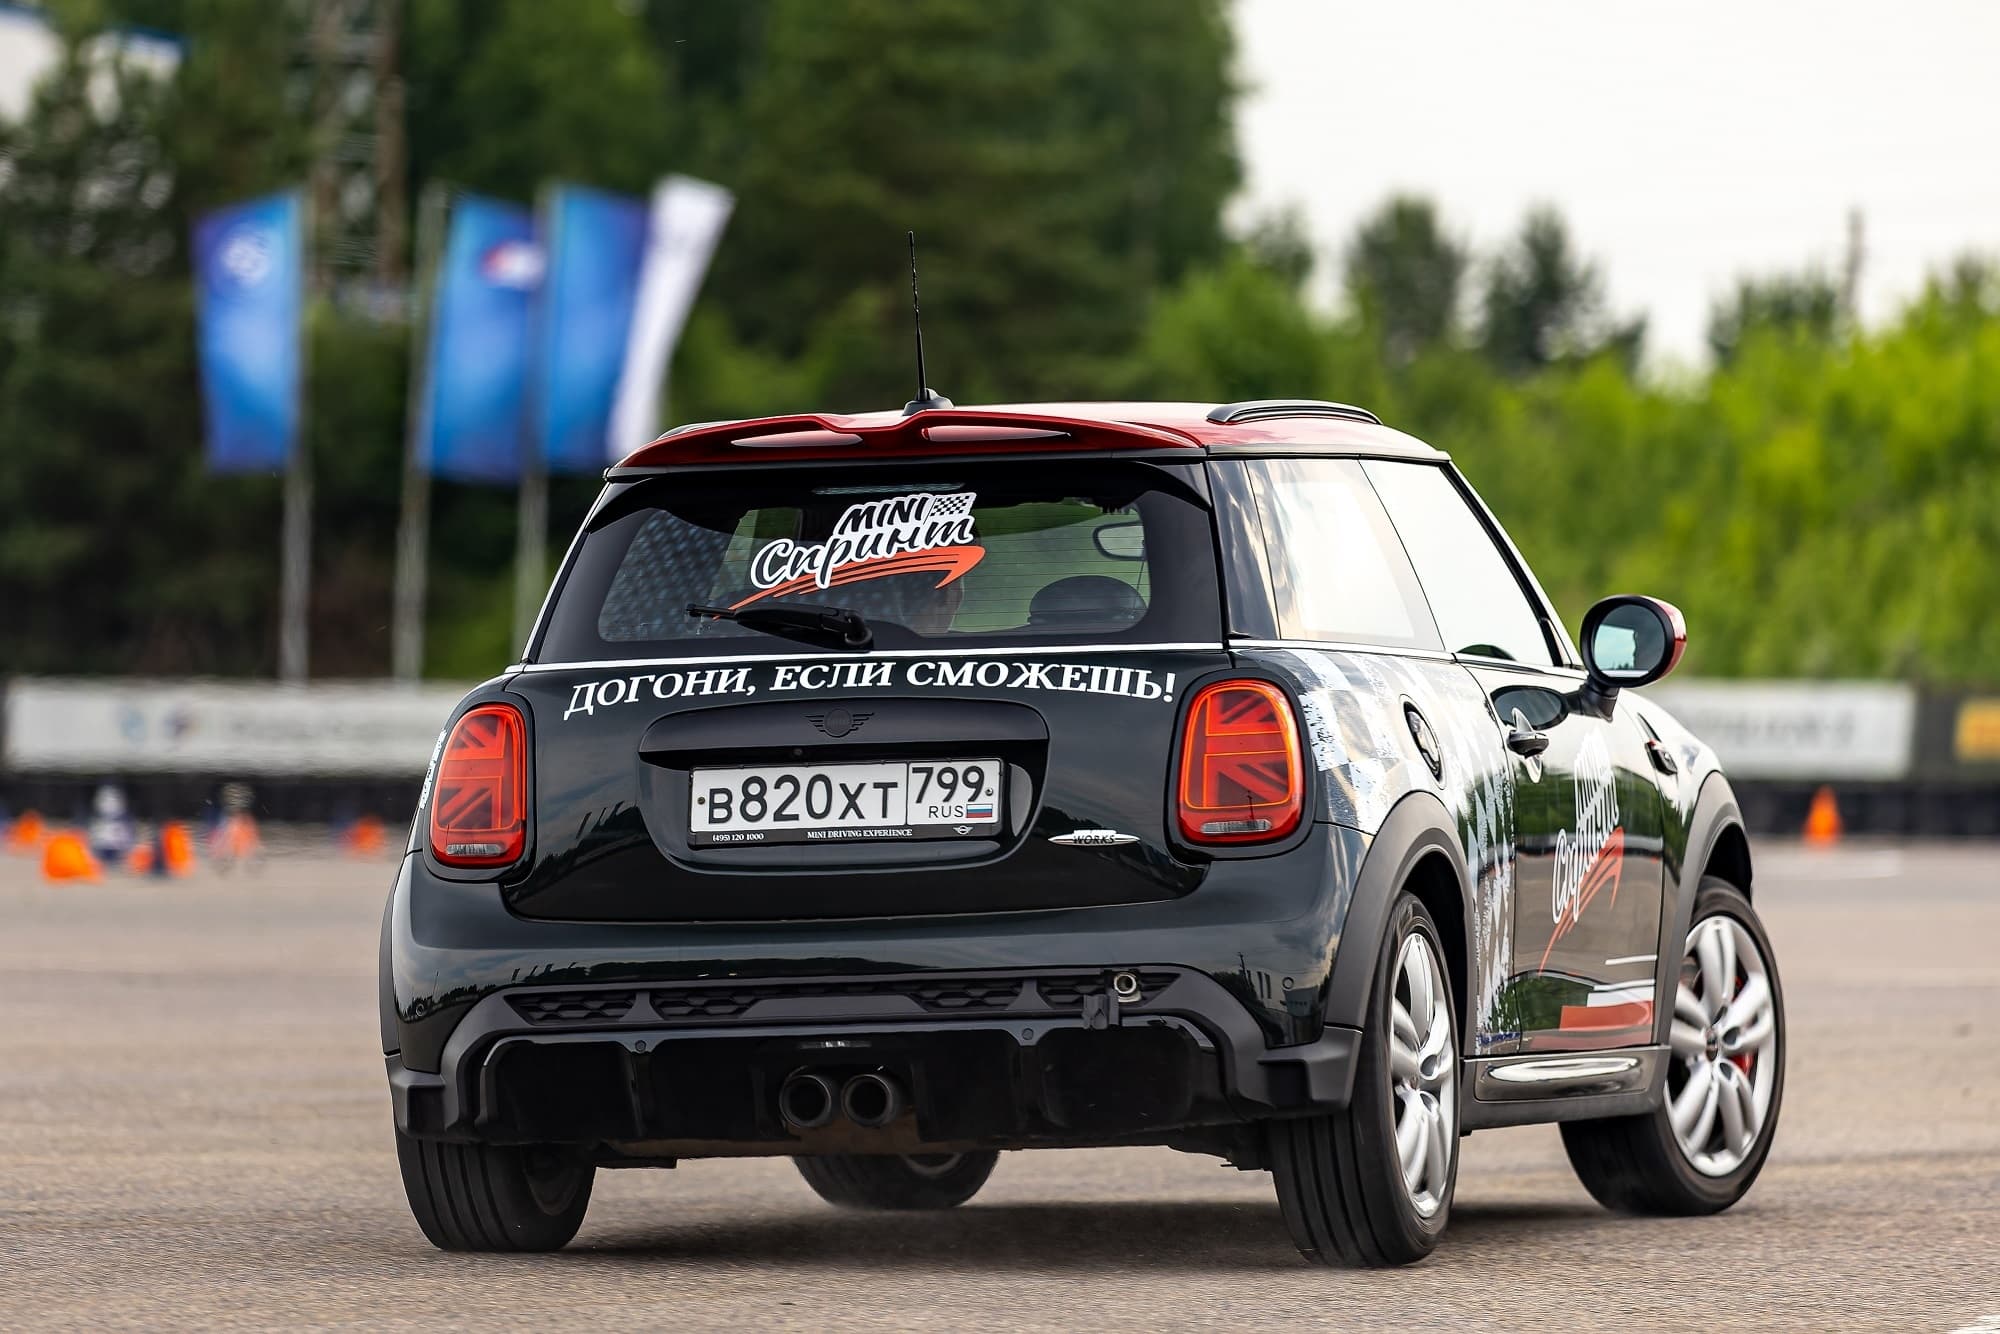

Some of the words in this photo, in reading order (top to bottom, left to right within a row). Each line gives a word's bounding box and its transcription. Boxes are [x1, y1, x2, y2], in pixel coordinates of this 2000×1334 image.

[836, 496, 930, 536] MINI
[752, 516, 972, 588] Спринт
[564, 667, 756, 721] ДОГОНИ,
[769, 662, 896, 691] ЕСЛИ
[906, 662, 1176, 703] СМОЖЕШЬ!
[911, 765, 985, 804] 799
[928, 804, 965, 819] RUS
[712, 834, 730, 842] (495)
[807, 831, 827, 840] MINI
[827, 829, 863, 839] DRIVING
[863, 828, 913, 838] EXPERIENCE
[1073, 834, 1116, 845] WORKS
